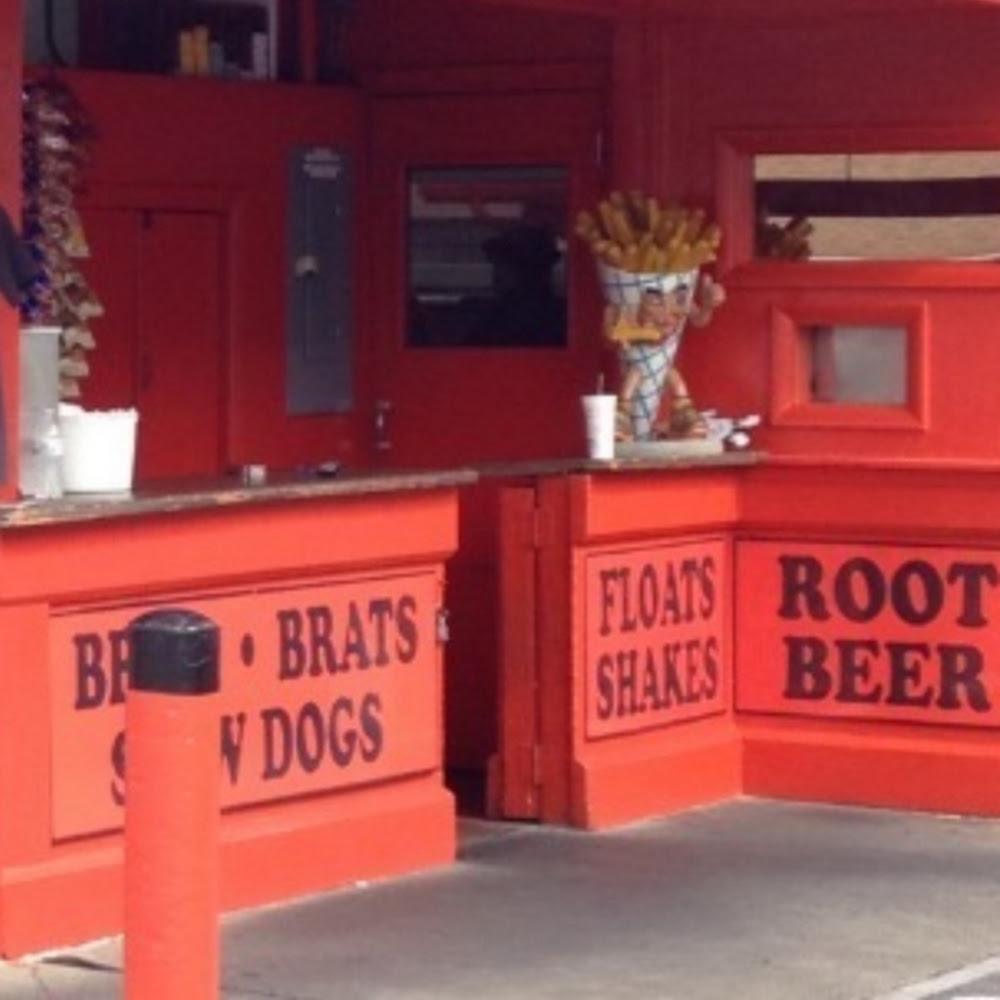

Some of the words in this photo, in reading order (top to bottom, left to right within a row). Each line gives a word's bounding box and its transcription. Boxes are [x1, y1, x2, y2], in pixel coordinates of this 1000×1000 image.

[598, 556, 715, 637] FLOATS
[778, 554, 999, 629] ROOT
[276, 594, 419, 681] BRATS
[596, 636, 719, 721] SHAKES
[782, 635, 992, 713] BEER
[260, 692, 384, 781] DOGS
